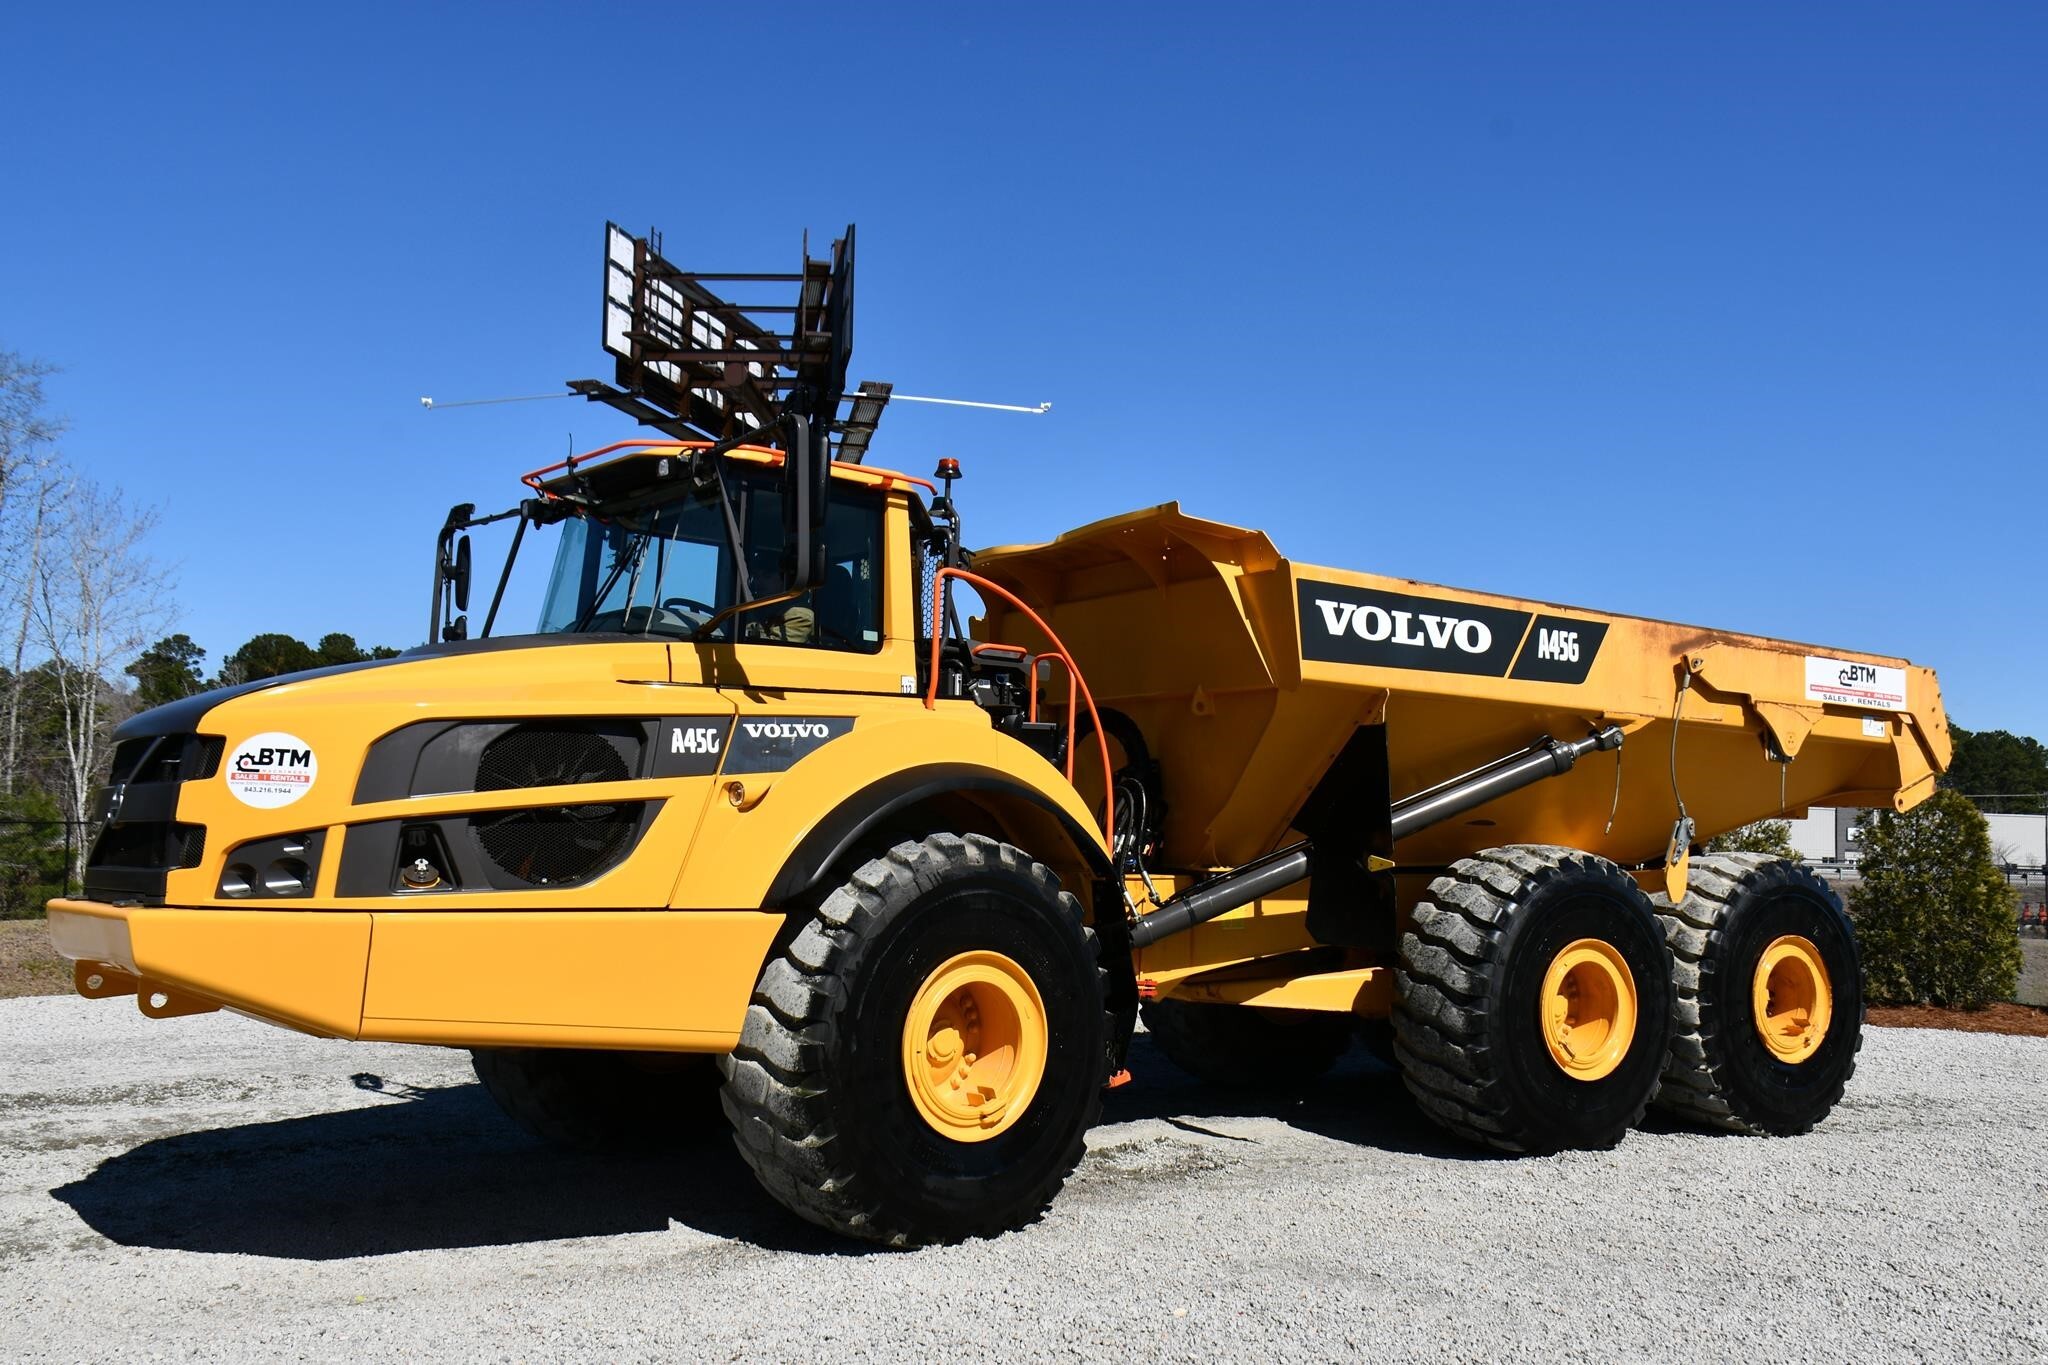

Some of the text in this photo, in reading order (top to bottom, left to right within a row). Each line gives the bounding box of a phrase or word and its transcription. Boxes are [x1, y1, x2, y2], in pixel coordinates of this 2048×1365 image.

[1315, 599, 1579, 663] VOLVO A45G
[1850, 665, 1876, 684] BTM
[1823, 694, 1891, 708] SALES RENTALS
[671, 723, 829, 754] A45G VOLVO
[259, 748, 311, 767] BTM
[270, 774, 305, 782] RENTALS
